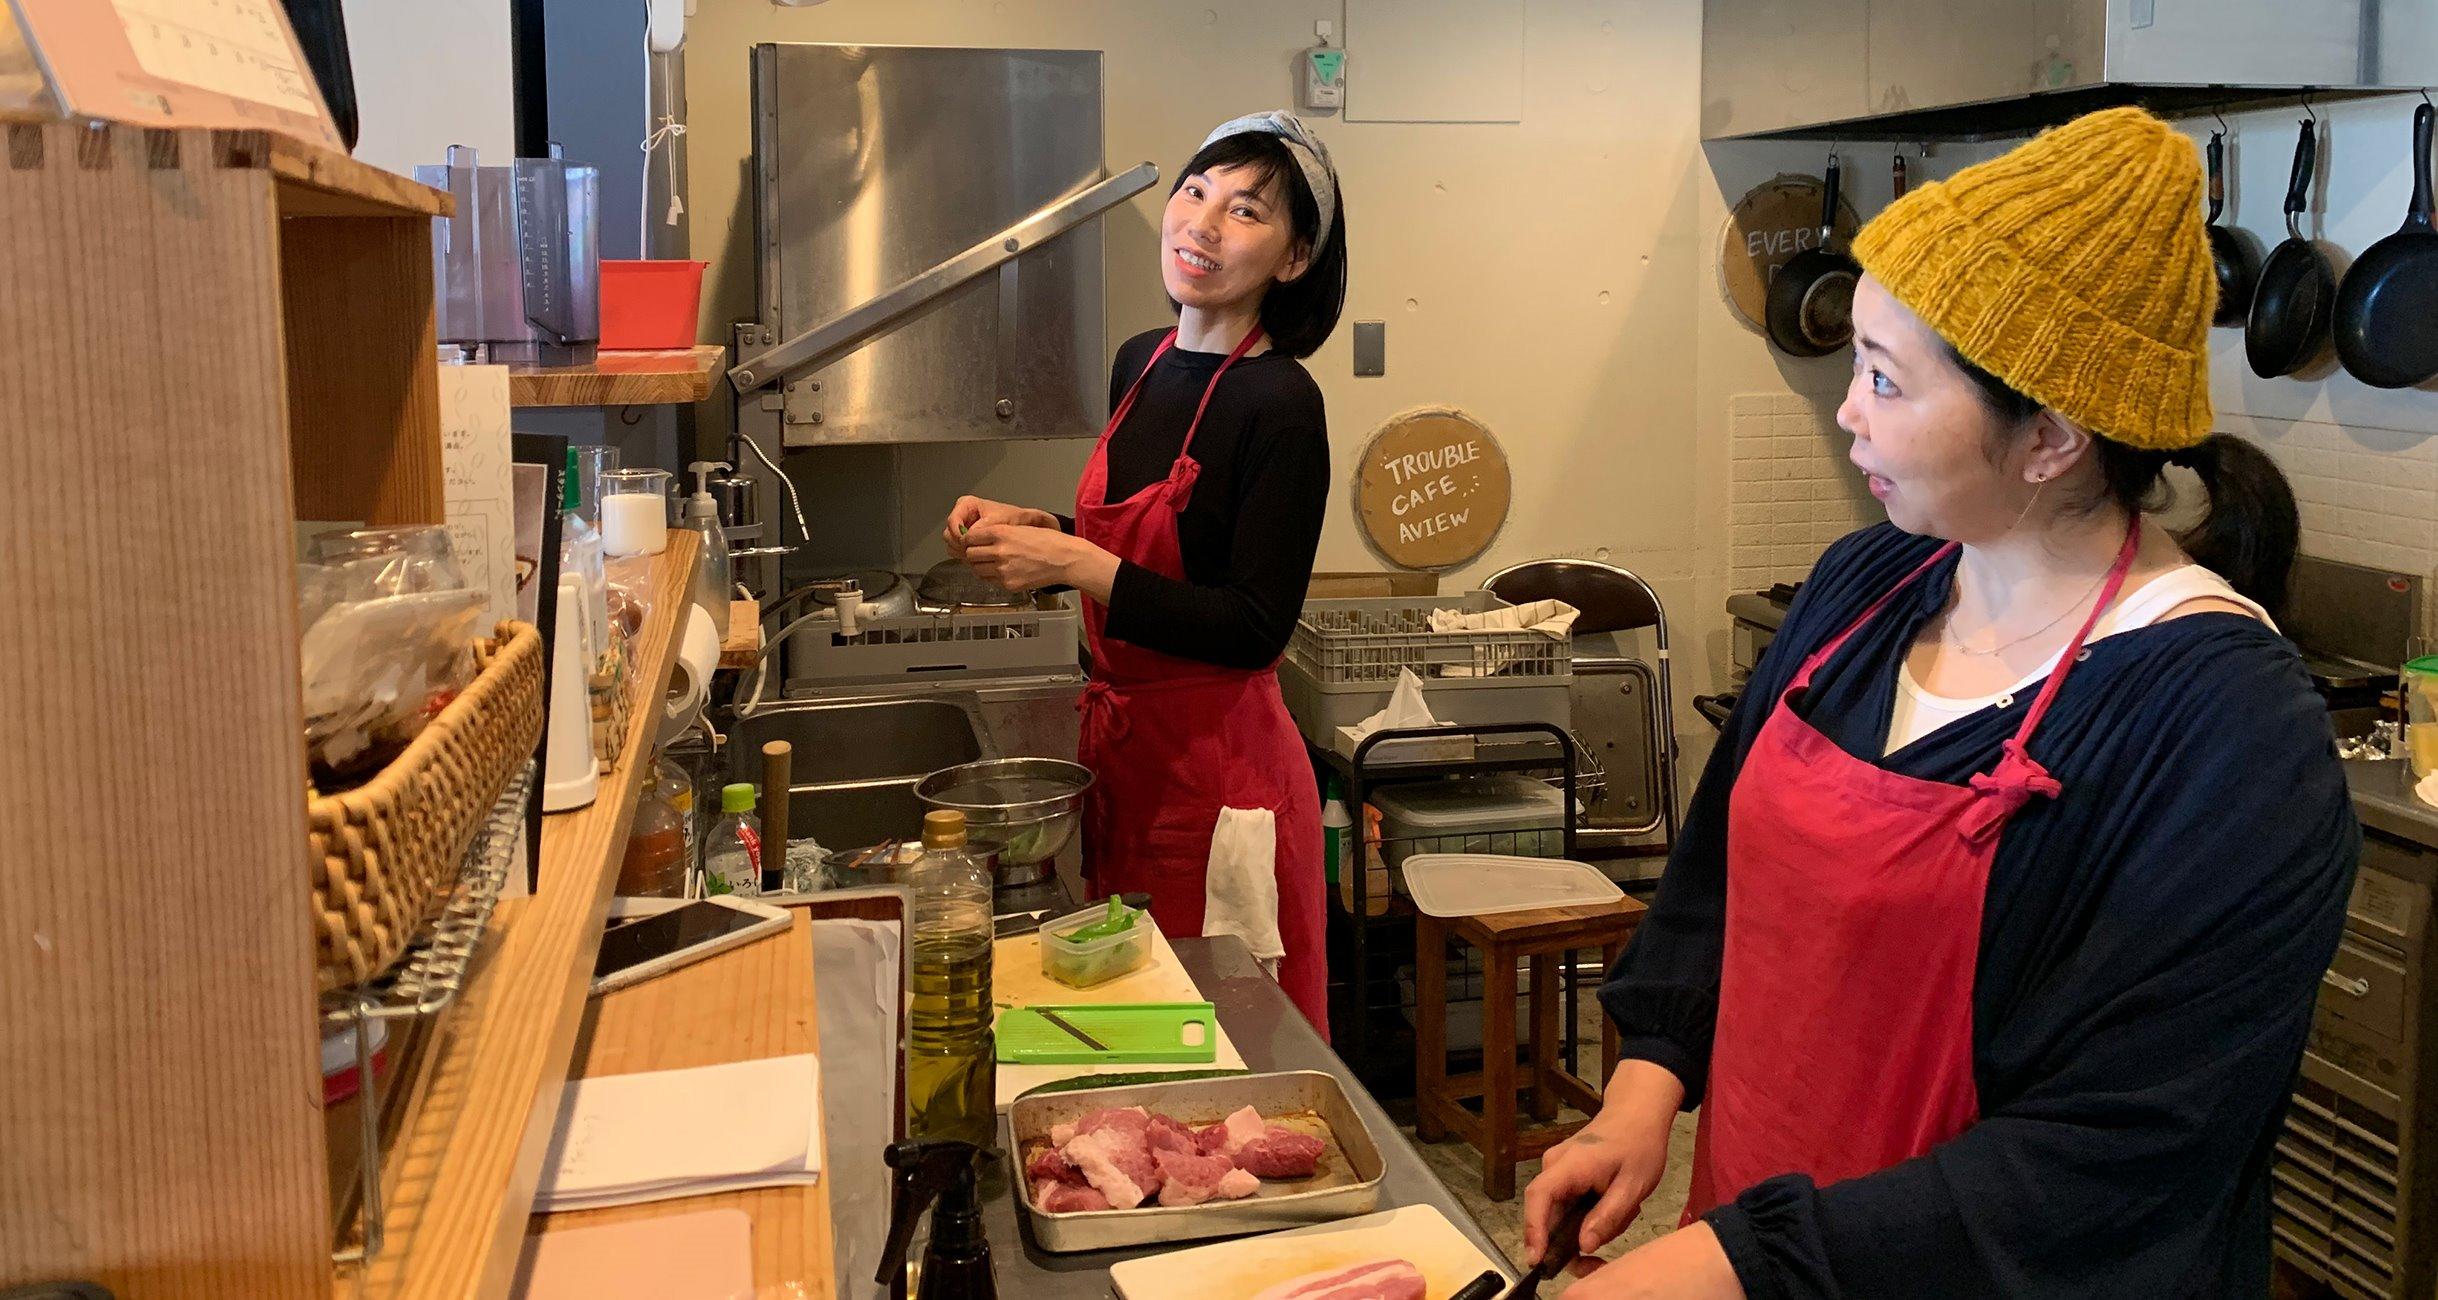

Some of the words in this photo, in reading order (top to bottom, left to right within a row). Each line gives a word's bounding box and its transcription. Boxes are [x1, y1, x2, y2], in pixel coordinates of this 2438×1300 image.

[1384, 440, 1480, 485] TROUBLE
[1391, 475, 1457, 516] CAFE
[1400, 508, 1470, 544] AVIEW
